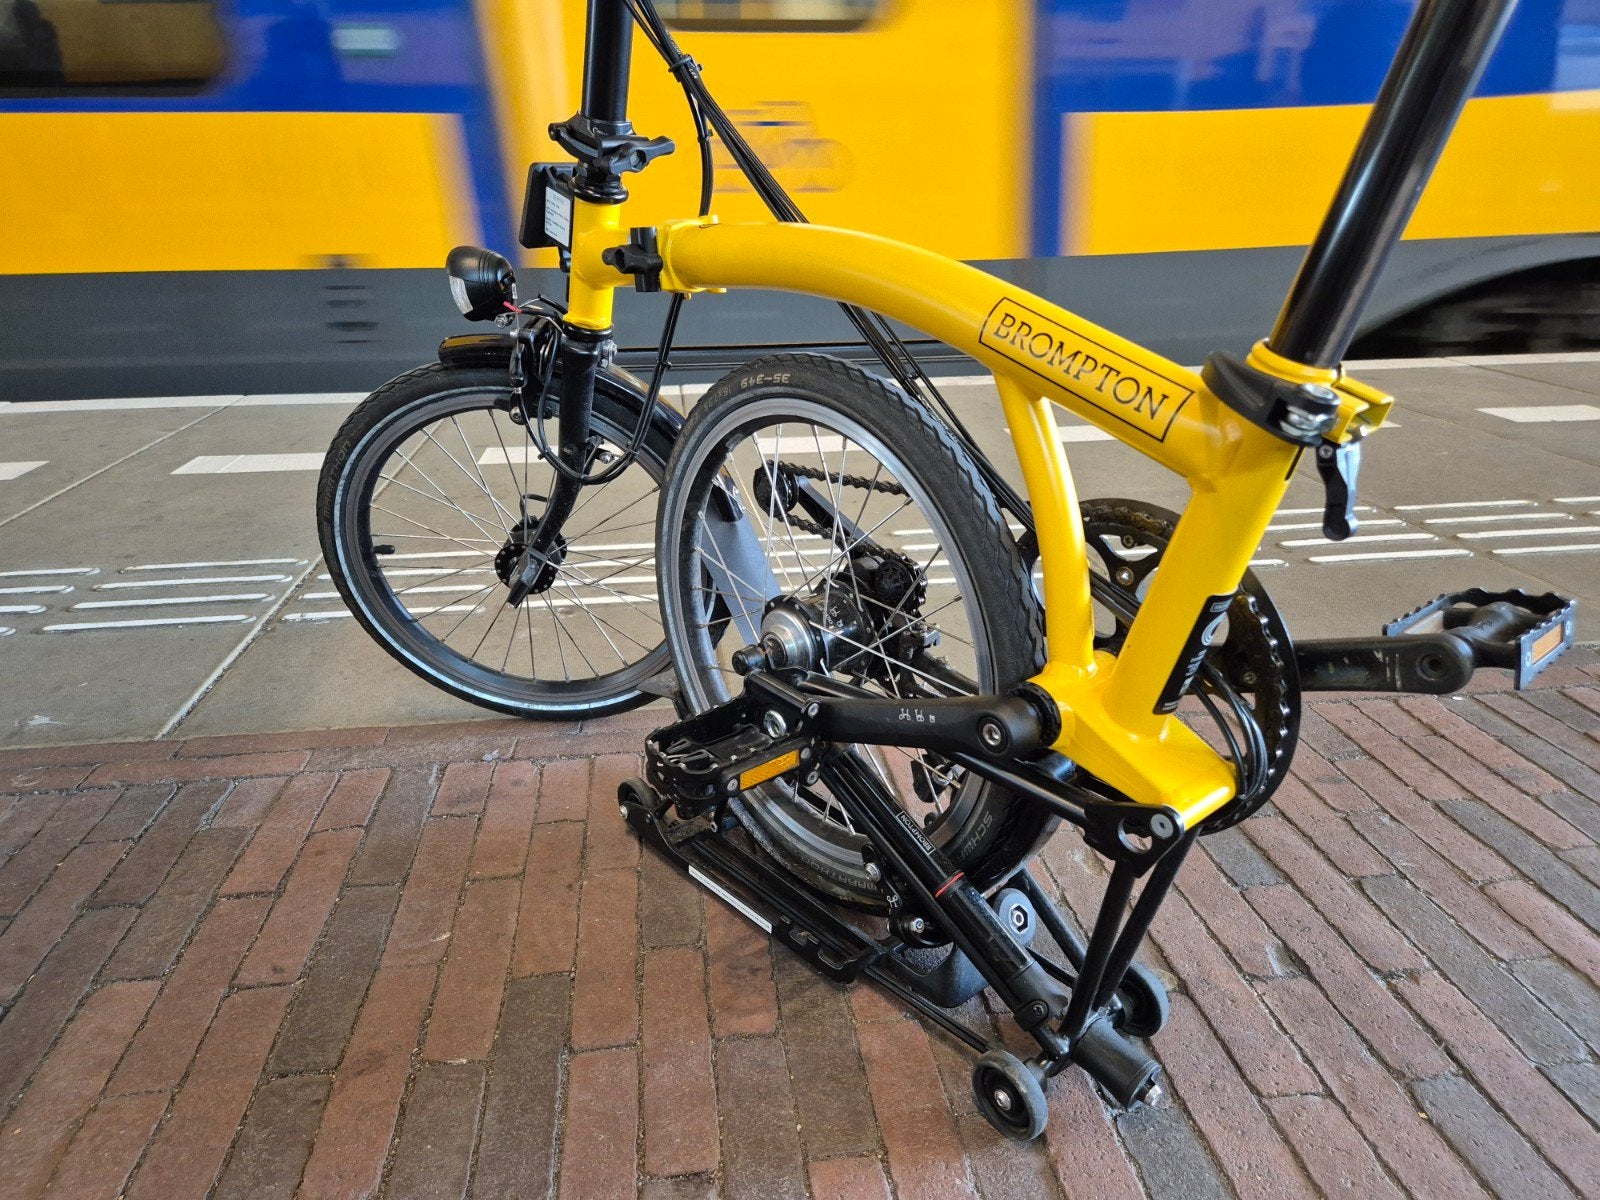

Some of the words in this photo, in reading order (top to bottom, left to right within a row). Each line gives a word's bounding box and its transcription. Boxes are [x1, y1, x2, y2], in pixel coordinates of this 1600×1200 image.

[741, 373, 791, 389] 35-349
[993, 312, 1170, 421] BROMPTON
[900, 814, 932, 852] BROMPTON
